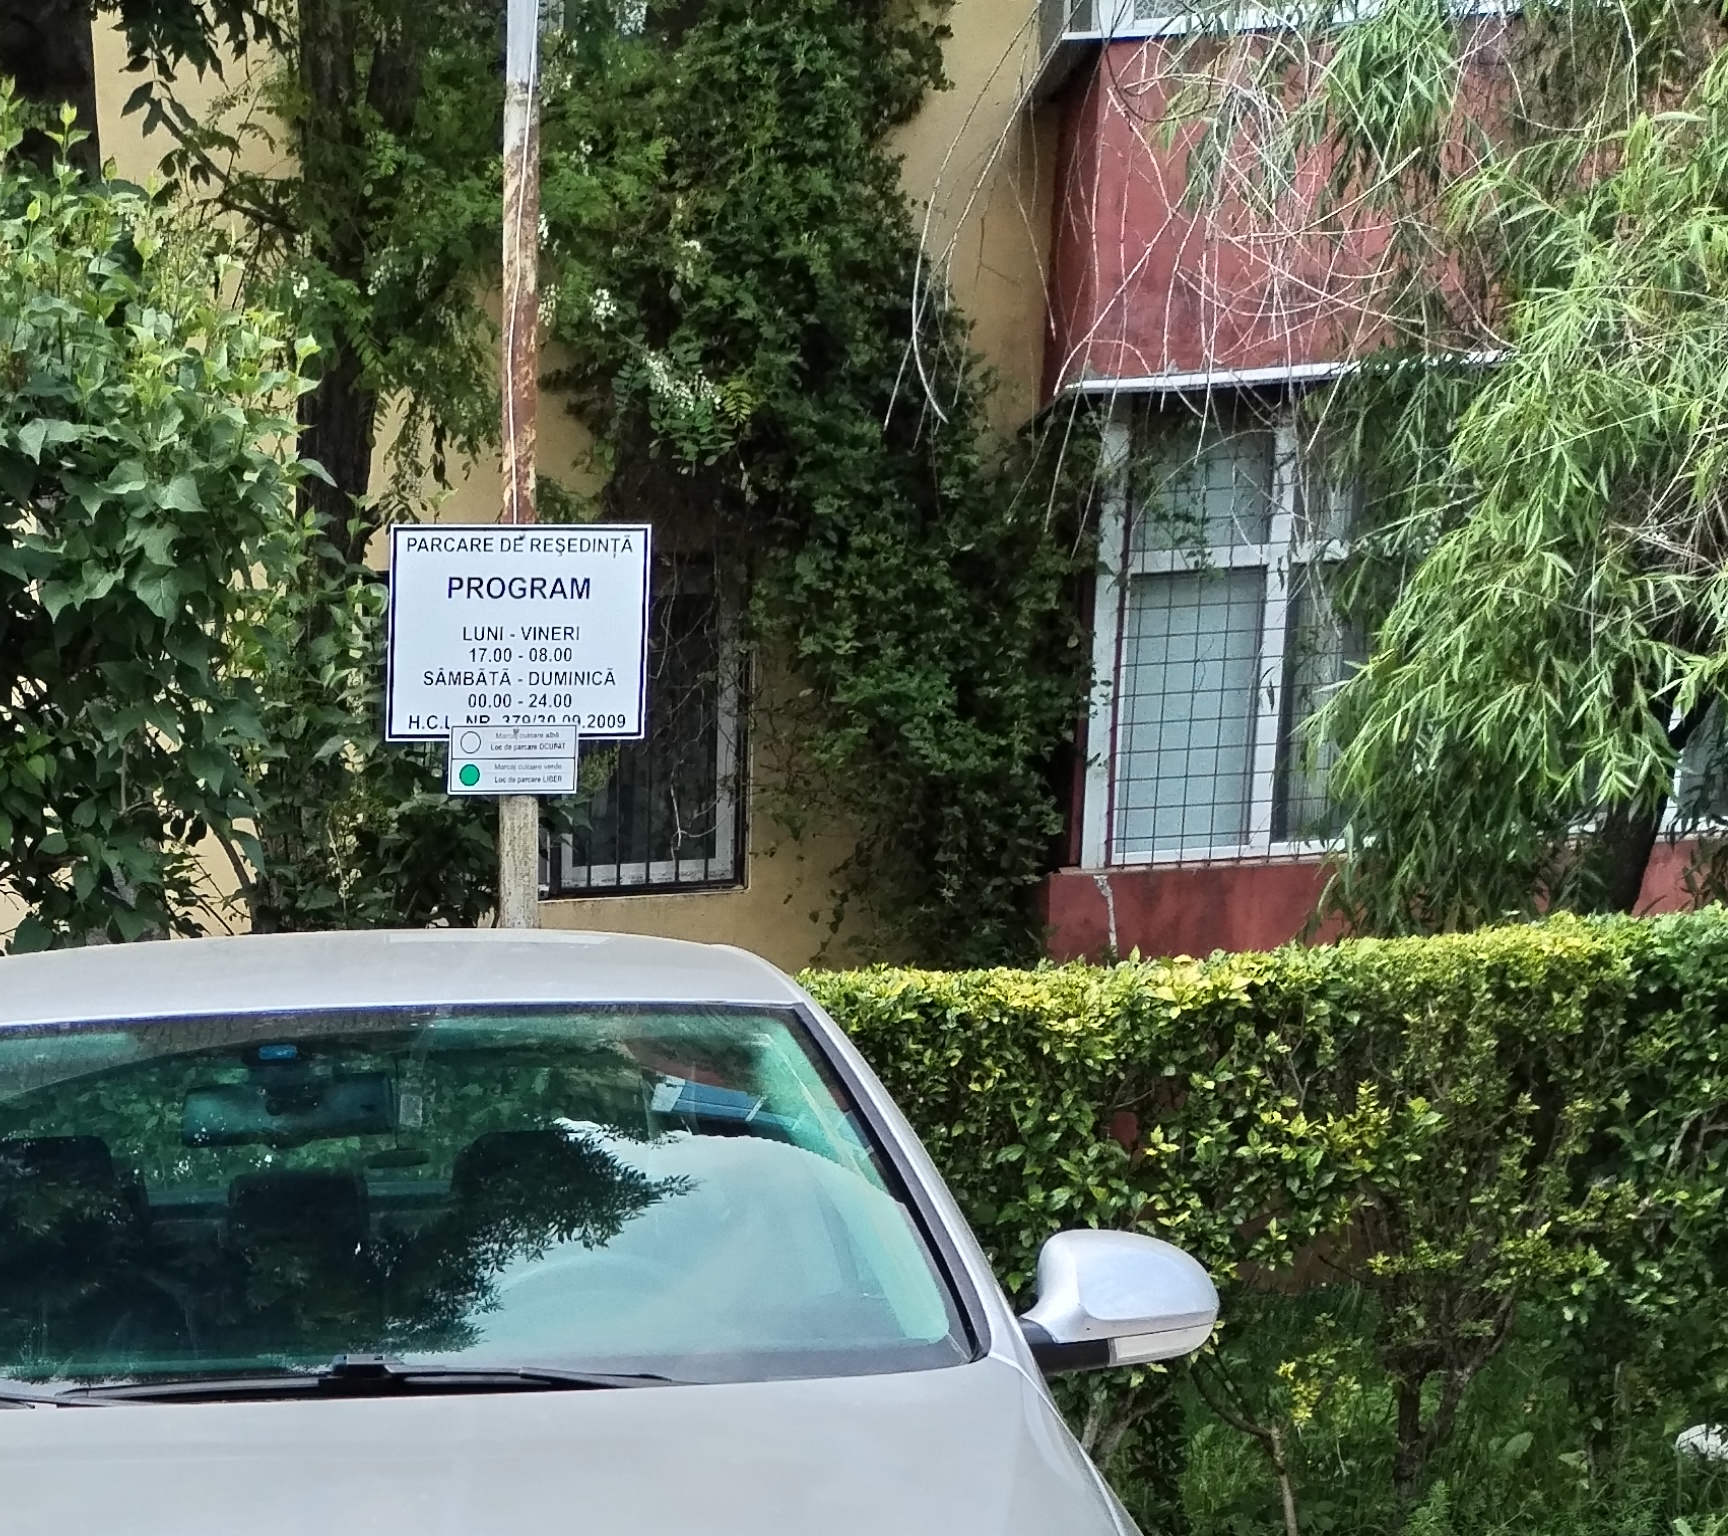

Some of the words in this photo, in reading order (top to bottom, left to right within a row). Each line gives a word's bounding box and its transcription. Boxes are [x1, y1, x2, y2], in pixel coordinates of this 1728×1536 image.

[406, 537, 494, 553] PARCARE
[500, 537, 523, 553] DE
[447, 577, 591, 600] PROGRAM
[462, 626, 504, 641] LUNI
[521, 626, 581, 641] VINERI
[469, 648, 512, 662] 17.00
[529, 647, 573, 662] 08.00
[468, 694, 512, 708] 00.00
[528, 693, 573, 708] 24.00
